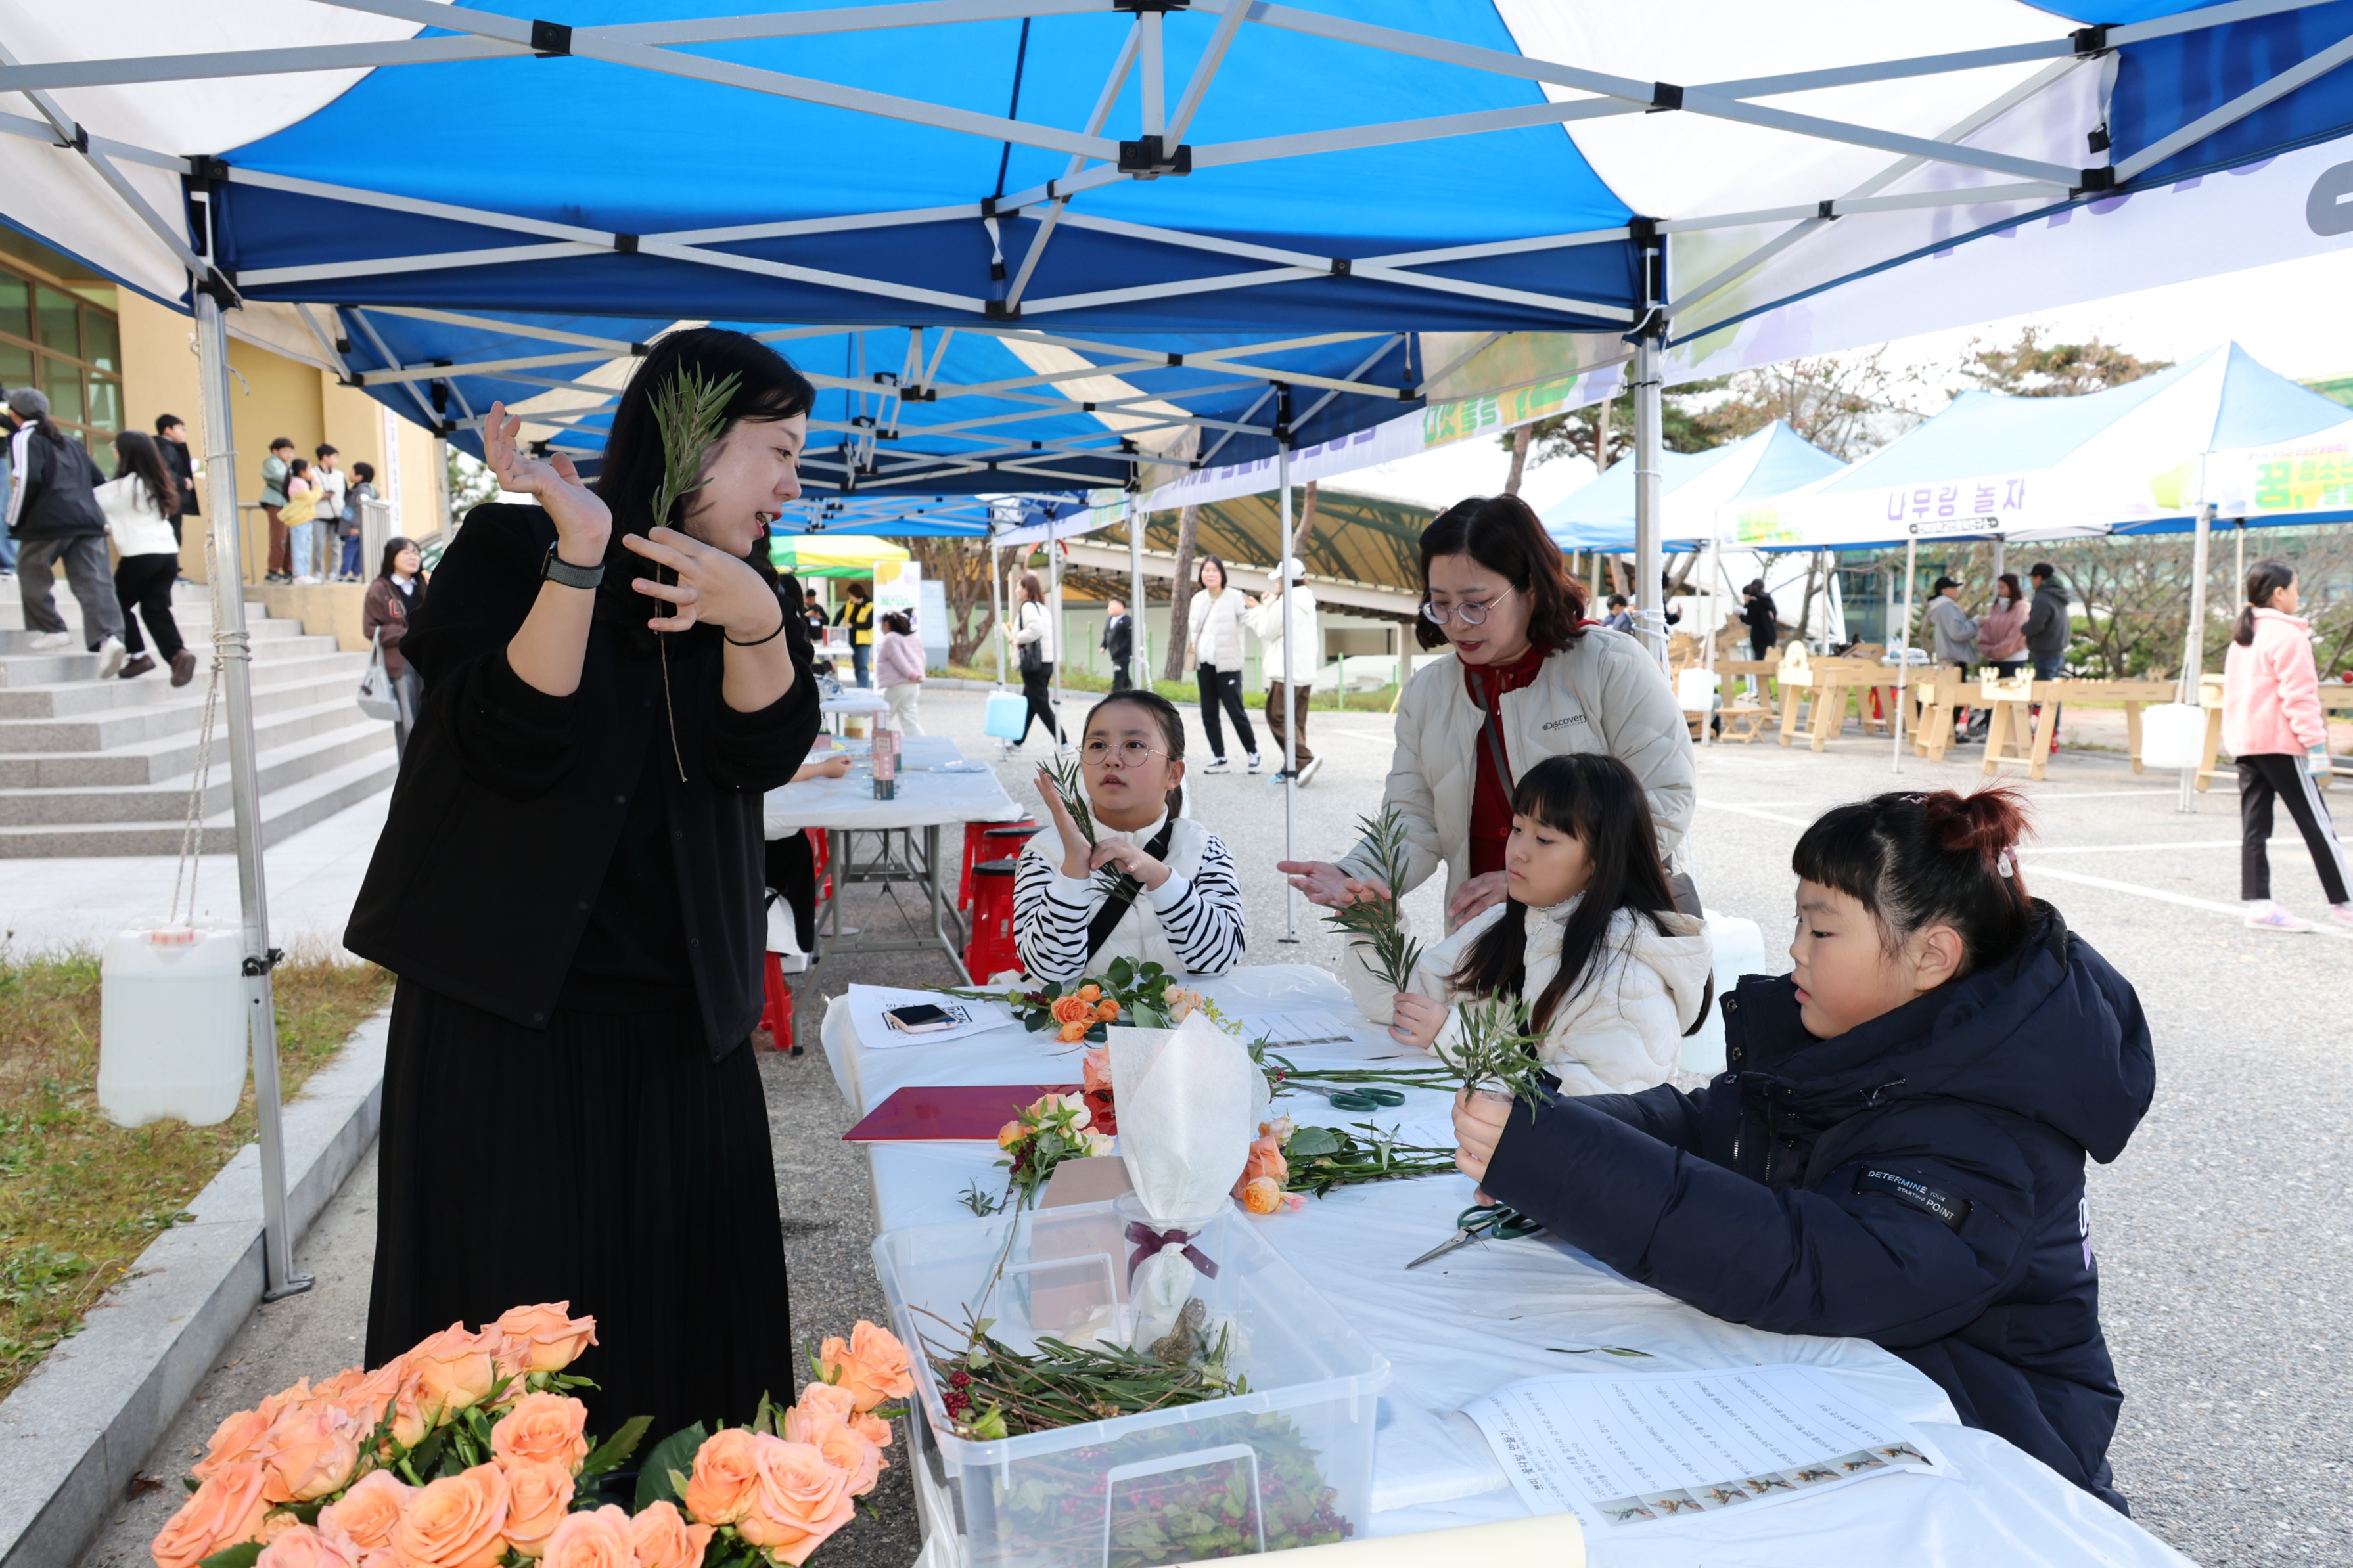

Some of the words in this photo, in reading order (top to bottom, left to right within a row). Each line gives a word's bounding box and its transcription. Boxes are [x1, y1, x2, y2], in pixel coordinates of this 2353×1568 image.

[1887, 485, 1958, 521] 나무랑
[1974, 478, 2026, 514] 놀자
[1867, 1171, 1928, 1194] DETERMINE
[1929, 1190, 1946, 1202] YOUR
[1897, 1186, 1926, 1202] STARTING
[1926, 1199, 1955, 1221] POINT
[1532, 1402, 1547, 1418] 오케이
[1543, 1420, 1559, 1436] 검지로
[1499, 1429, 1520, 1451] 만들기
[1553, 1437, 1571, 1454] 엄지와
[1605, 1435, 1619, 1445] 겹쳐
[1708, 1439, 1722, 1449] 아래
[1614, 1446, 1630, 1460] 아래로
[1513, 1454, 1536, 1475] 꽃다발
[1566, 1455, 1585, 1475] 기린초를
[1583, 1459, 1601, 1474] 만들어
[1633, 1467, 1651, 1479] 장미를
[1528, 1477, 1545, 1490] 쁘띠
[1582, 1476, 1607, 1498] 그린소재와
[1595, 1474, 1622, 1496] 동그라미를
[1647, 1480, 1660, 1490] 미니
